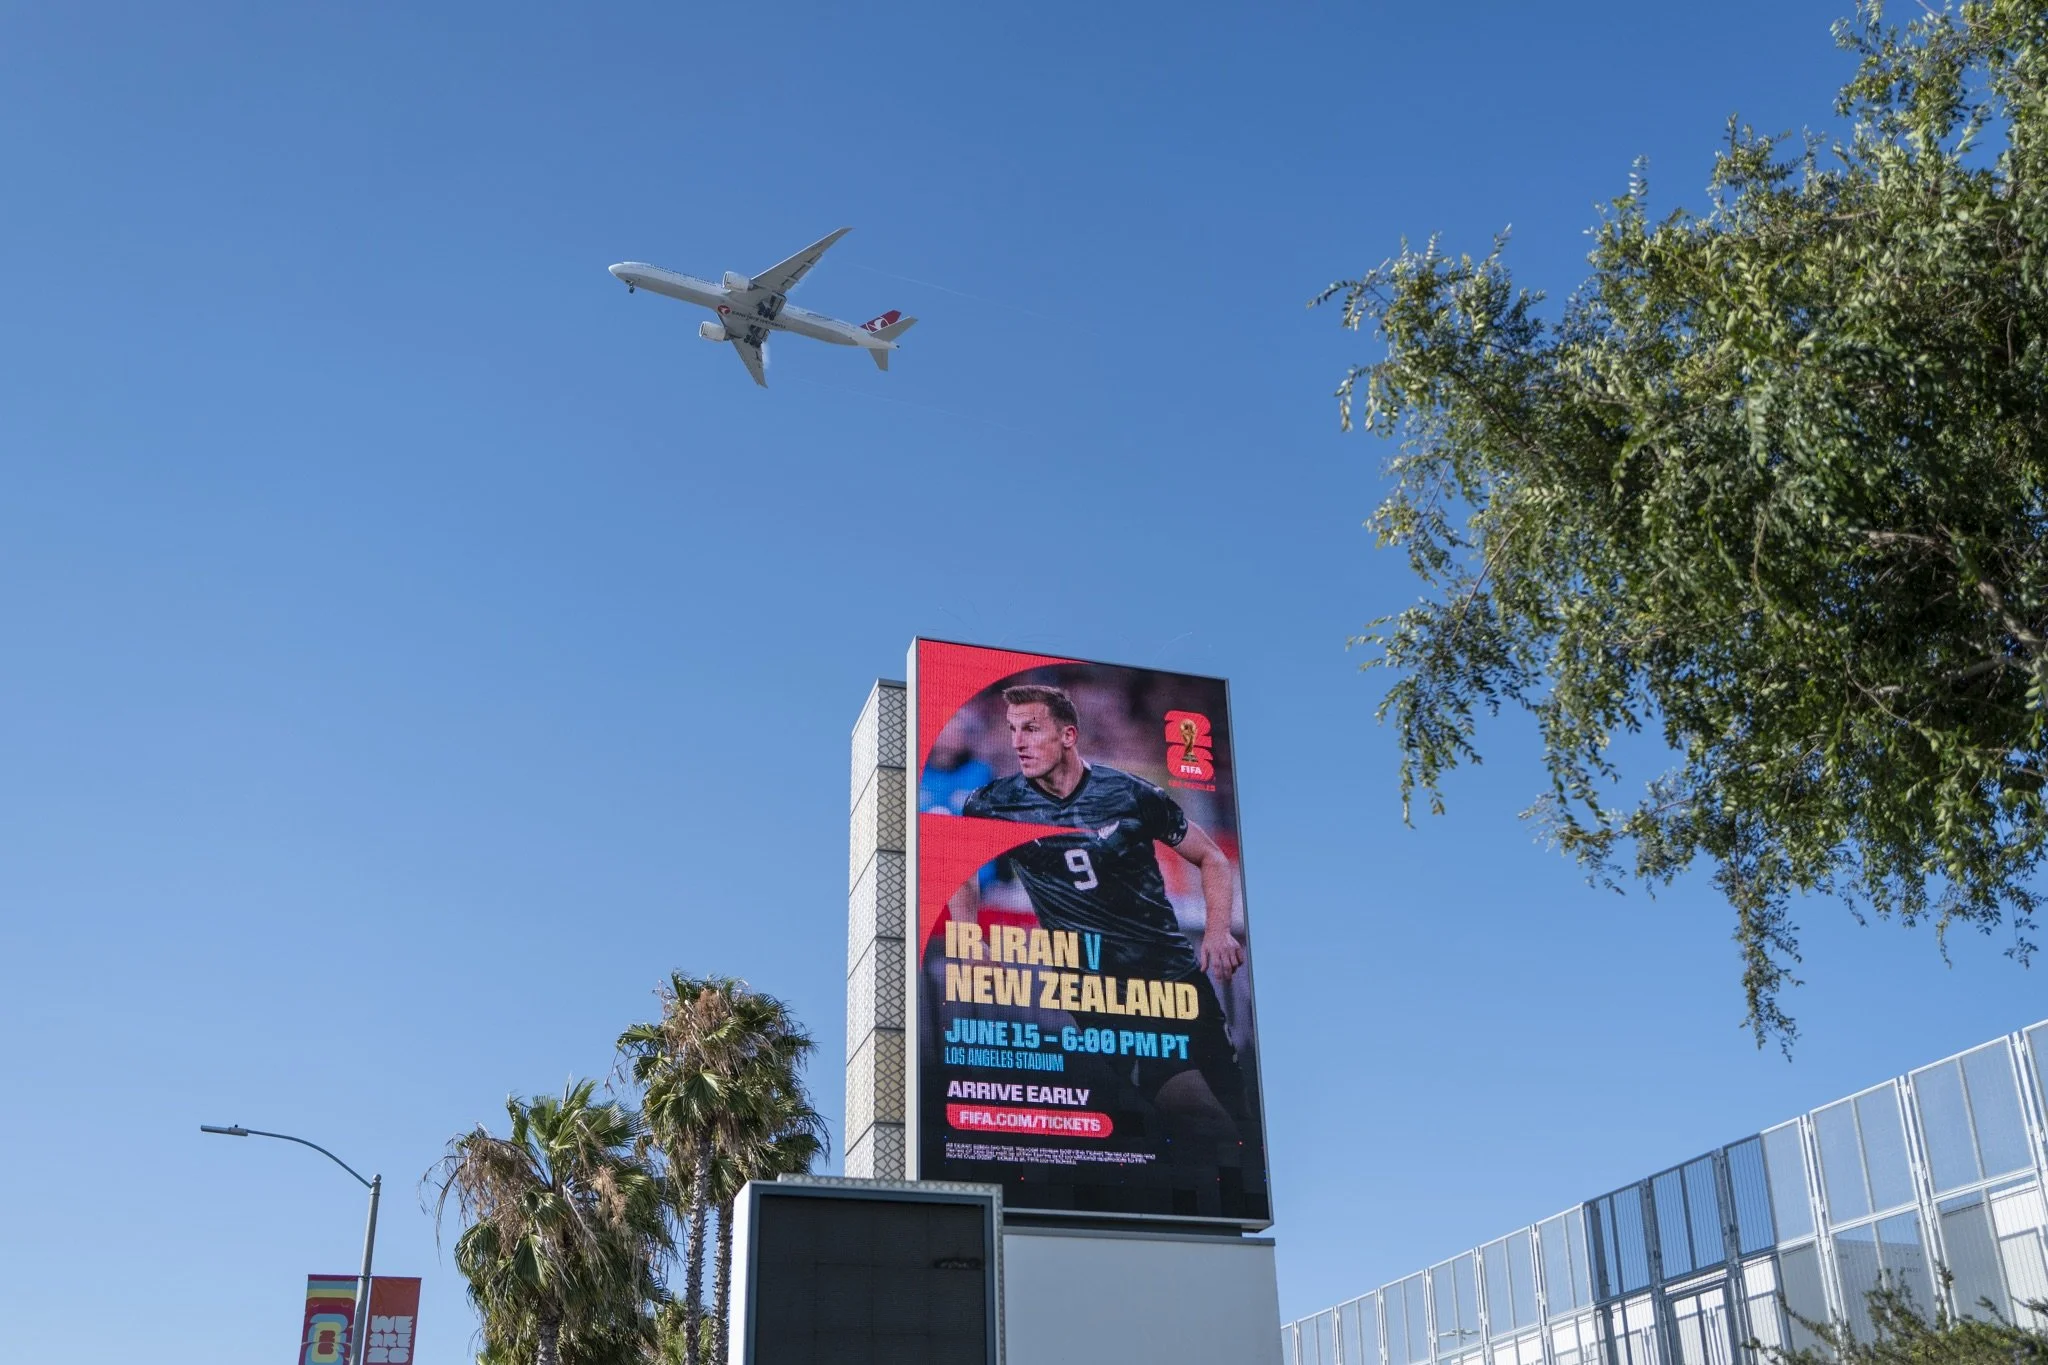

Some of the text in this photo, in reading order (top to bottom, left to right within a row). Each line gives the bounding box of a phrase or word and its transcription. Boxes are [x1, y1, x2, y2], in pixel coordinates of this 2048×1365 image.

[1180, 765, 1203, 775] FIFA
[1064, 848, 1098, 891] 9
[945, 920, 1102, 970] IR IRAN V
[945, 963, 1200, 1020] NEW ZEALAND
[945, 1018, 1008, 1047] JUNE
[1011, 1023, 1040, 1049] 15
[1062, 1025, 1116, 1055] 6:00
[1120, 1030, 1159, 1057] PM
[1161, 1033, 1190, 1060] PT
[945, 1046, 1064, 1072] LOS ANGELES STADIUM
[947, 1080, 1090, 1106] ARRIVE EARLY
[959, 1111, 1101, 1132] FIFA.COM/TICKETS
